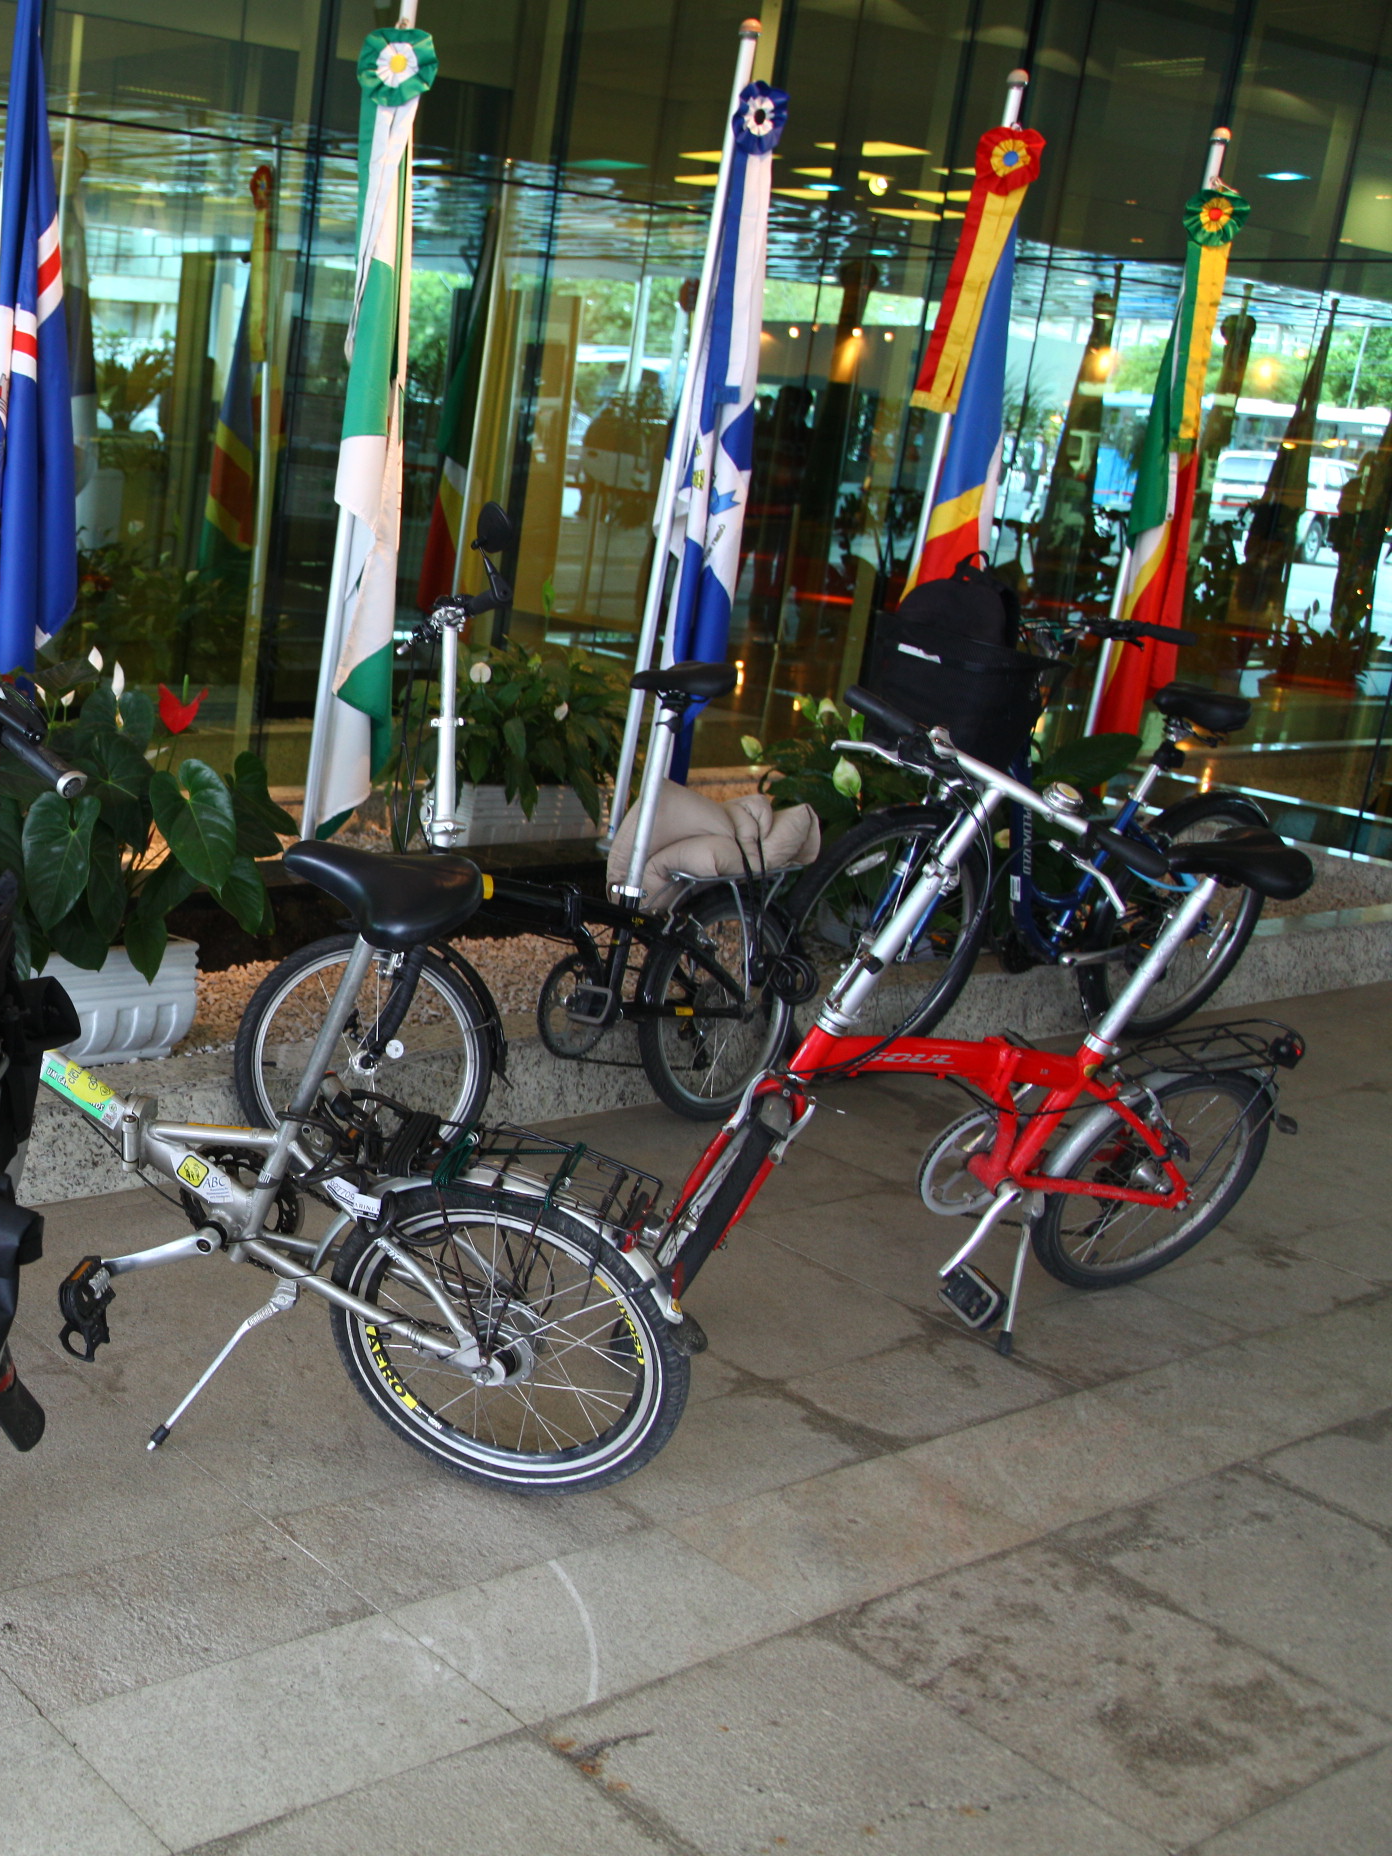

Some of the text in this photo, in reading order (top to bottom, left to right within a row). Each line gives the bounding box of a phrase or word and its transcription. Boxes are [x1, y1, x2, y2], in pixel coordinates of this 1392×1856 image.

[46, 1067, 58, 1080] UM
[202, 1174, 227, 1189] ABC
[365, 1333, 409, 1398] AERO
